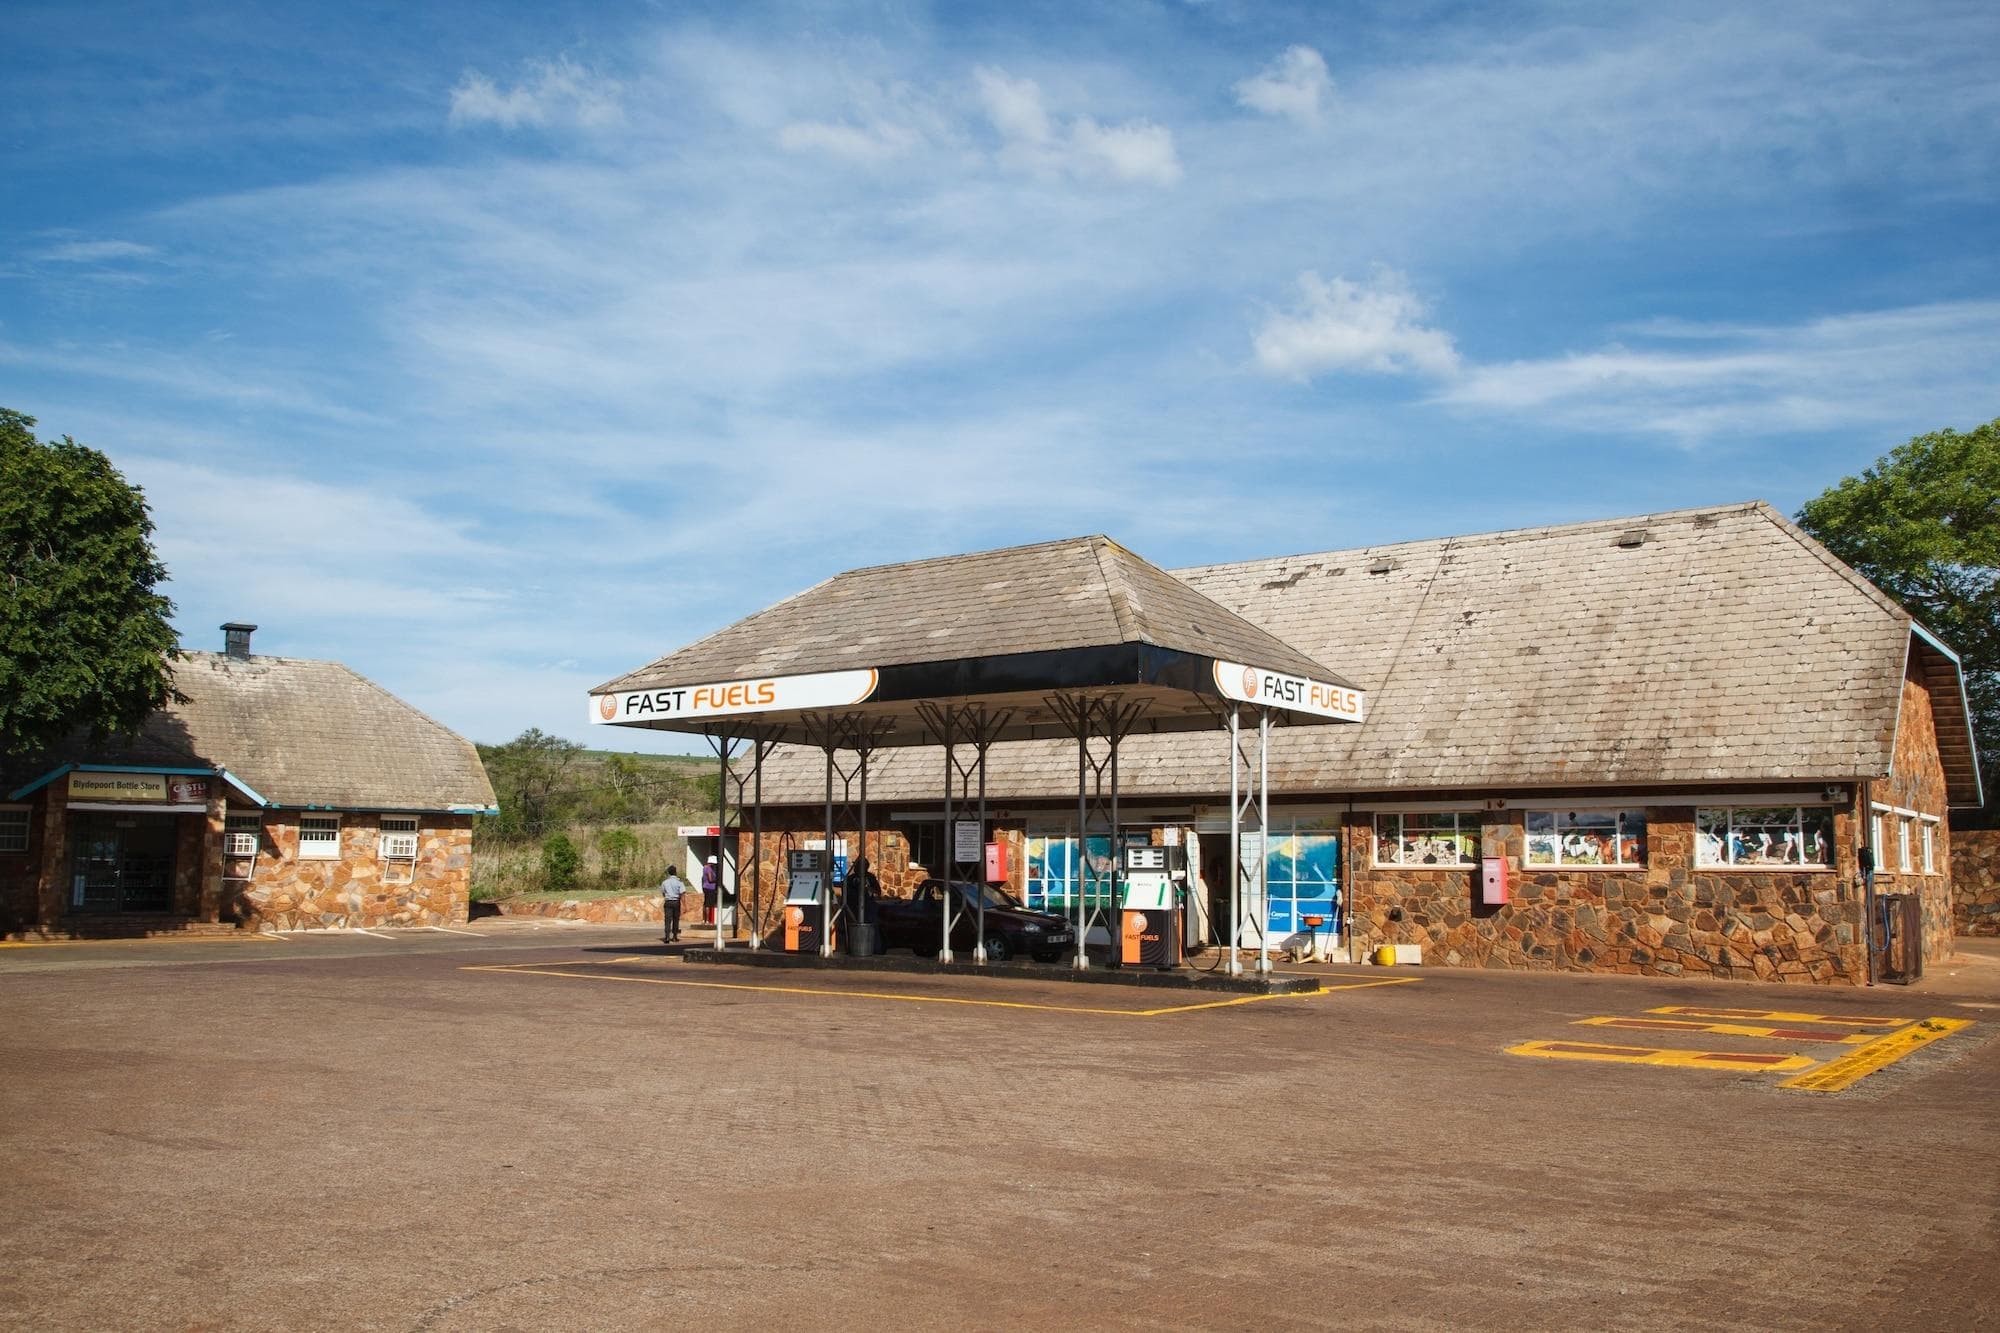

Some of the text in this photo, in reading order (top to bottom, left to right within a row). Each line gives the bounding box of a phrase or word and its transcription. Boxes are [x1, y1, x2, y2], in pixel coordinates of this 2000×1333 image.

[625, 683, 775, 715] FAST FUELS
[1264, 676, 1357, 714] FAST FUELS
[73, 780, 160, 791] Blydepoort Bottle Store
